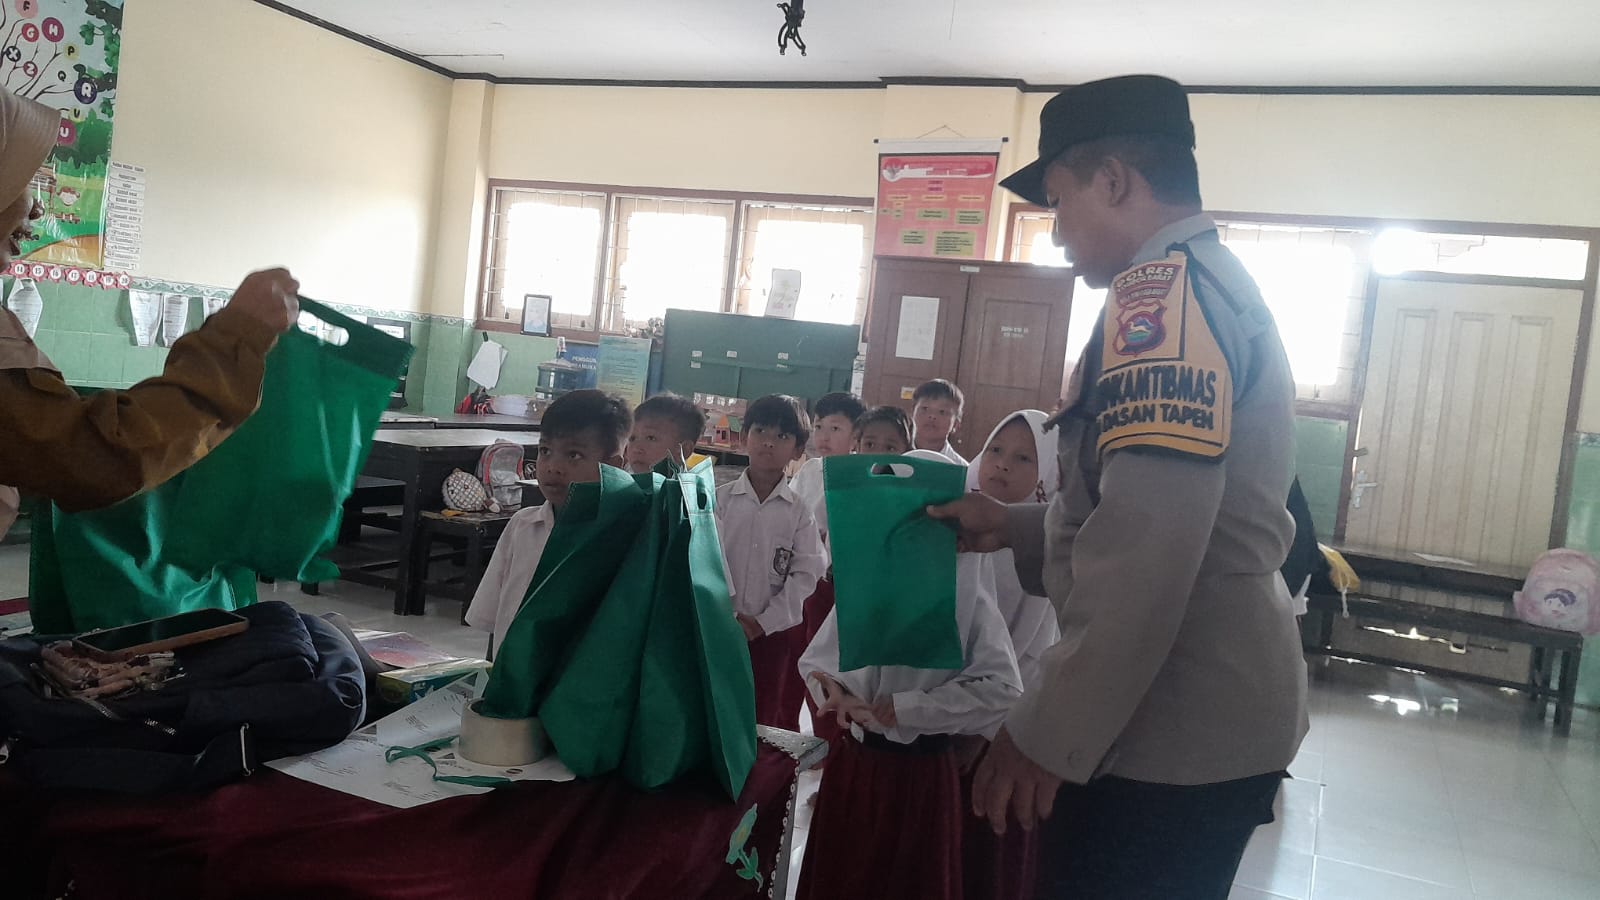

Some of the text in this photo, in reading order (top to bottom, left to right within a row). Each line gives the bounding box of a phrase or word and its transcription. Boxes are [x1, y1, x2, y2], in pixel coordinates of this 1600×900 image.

[23, 0, 30, 11] F
[26, 28, 35, 38] G
[49, 24, 58, 36] H
[68, 46, 75, 56] P
[57, 70, 66, 82] Q
[81, 82, 91, 98] R
[60, 126, 69, 138] U
[1116, 266, 1174, 287] POLRES
[1159, 403, 1214, 431] TAPEN
